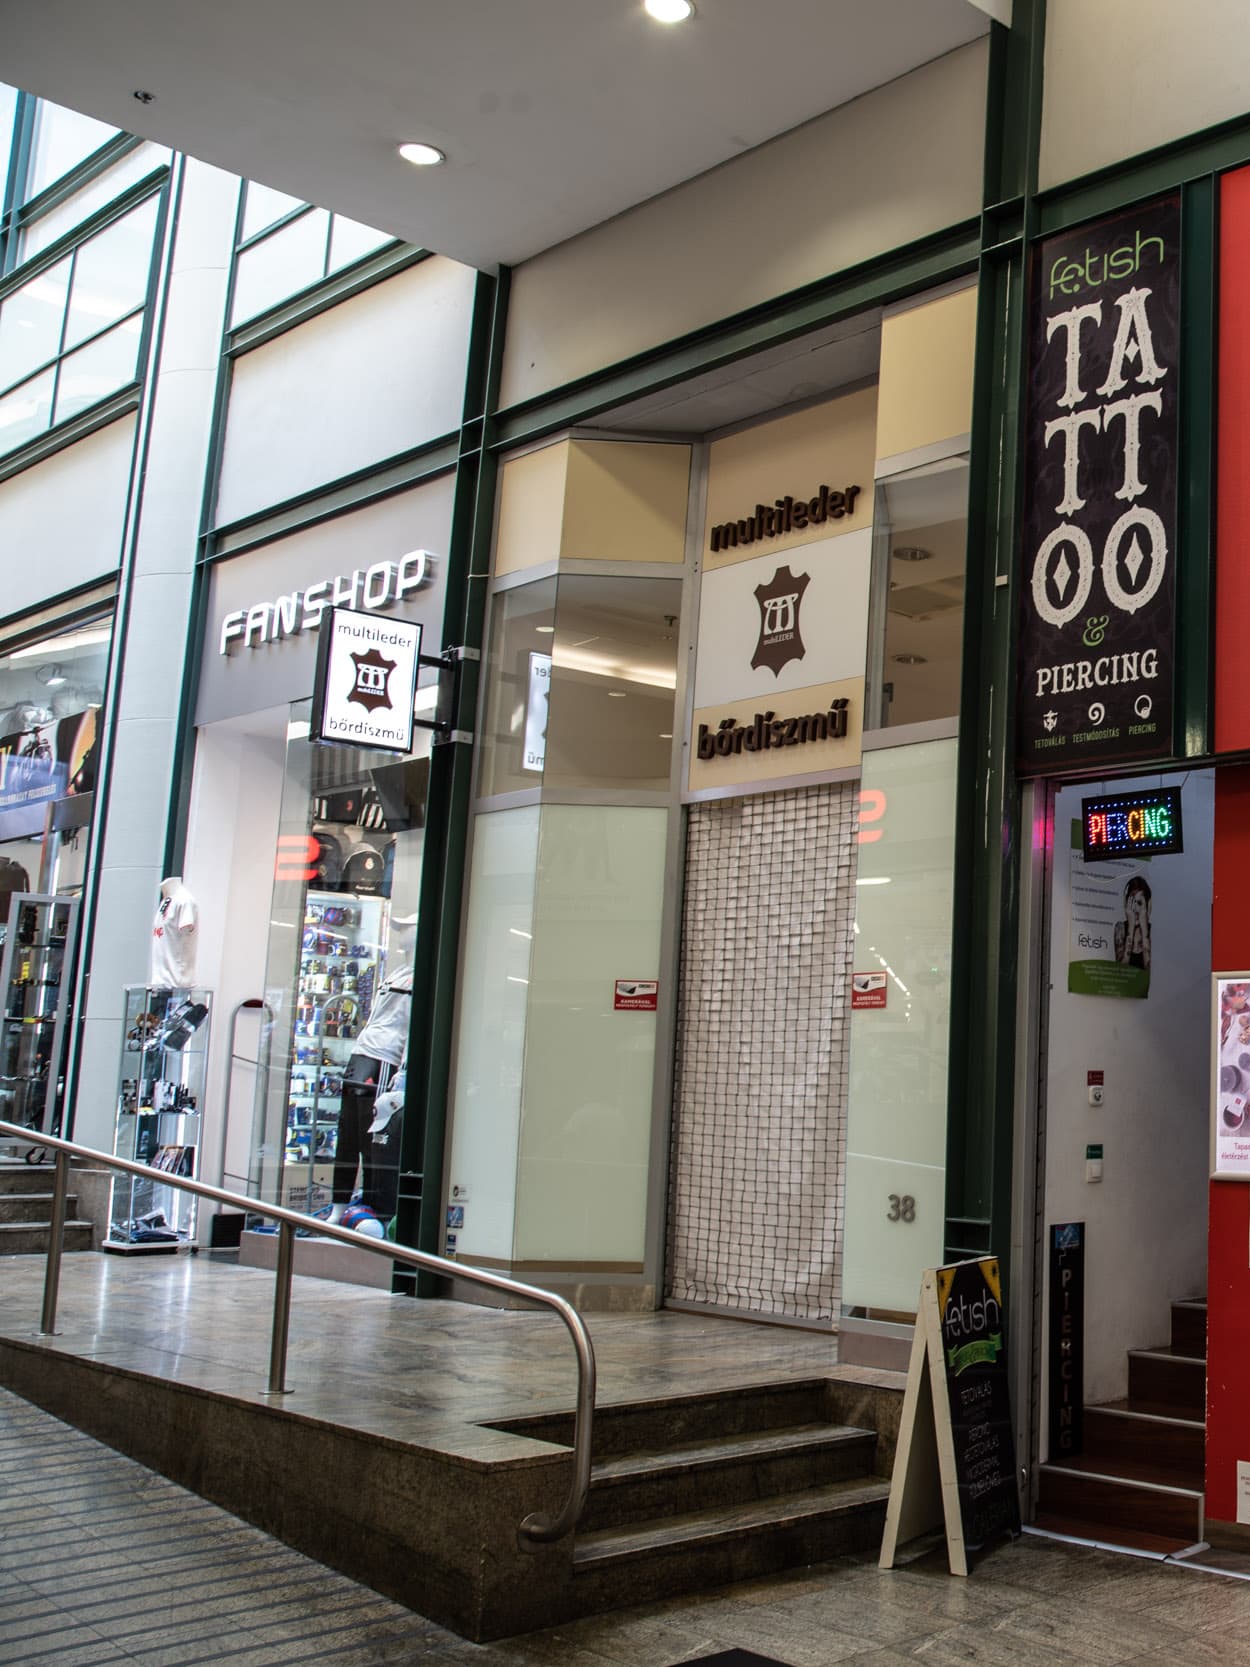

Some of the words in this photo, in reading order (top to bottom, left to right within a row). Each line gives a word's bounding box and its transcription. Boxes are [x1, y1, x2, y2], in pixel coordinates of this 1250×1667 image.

[1048, 230, 1164, 301] fetish
[710, 484, 862, 552] multileder
[219, 549, 432, 656] FANSHOP
[338, 624, 413, 648] multileder
[1082, 614, 1110, 647] &
[1035, 648, 1159, 697] PIERCING
[697, 697, 851, 761] bőrdíszmű
[1034, 735, 1066, 749] TETOVÁLÁS
[1072, 727, 1120, 744] TESTMÓDOSÍTÁS
[1128, 722, 1157, 736] PIERCING
[1089, 806, 1171, 846] PIERCING
[1077, 932, 1109, 950] fetish
[886, 1193, 917, 1224] 38
[944, 1287, 1000, 1339] fetish
[1058, 1268, 1073, 1450] PIERCING
